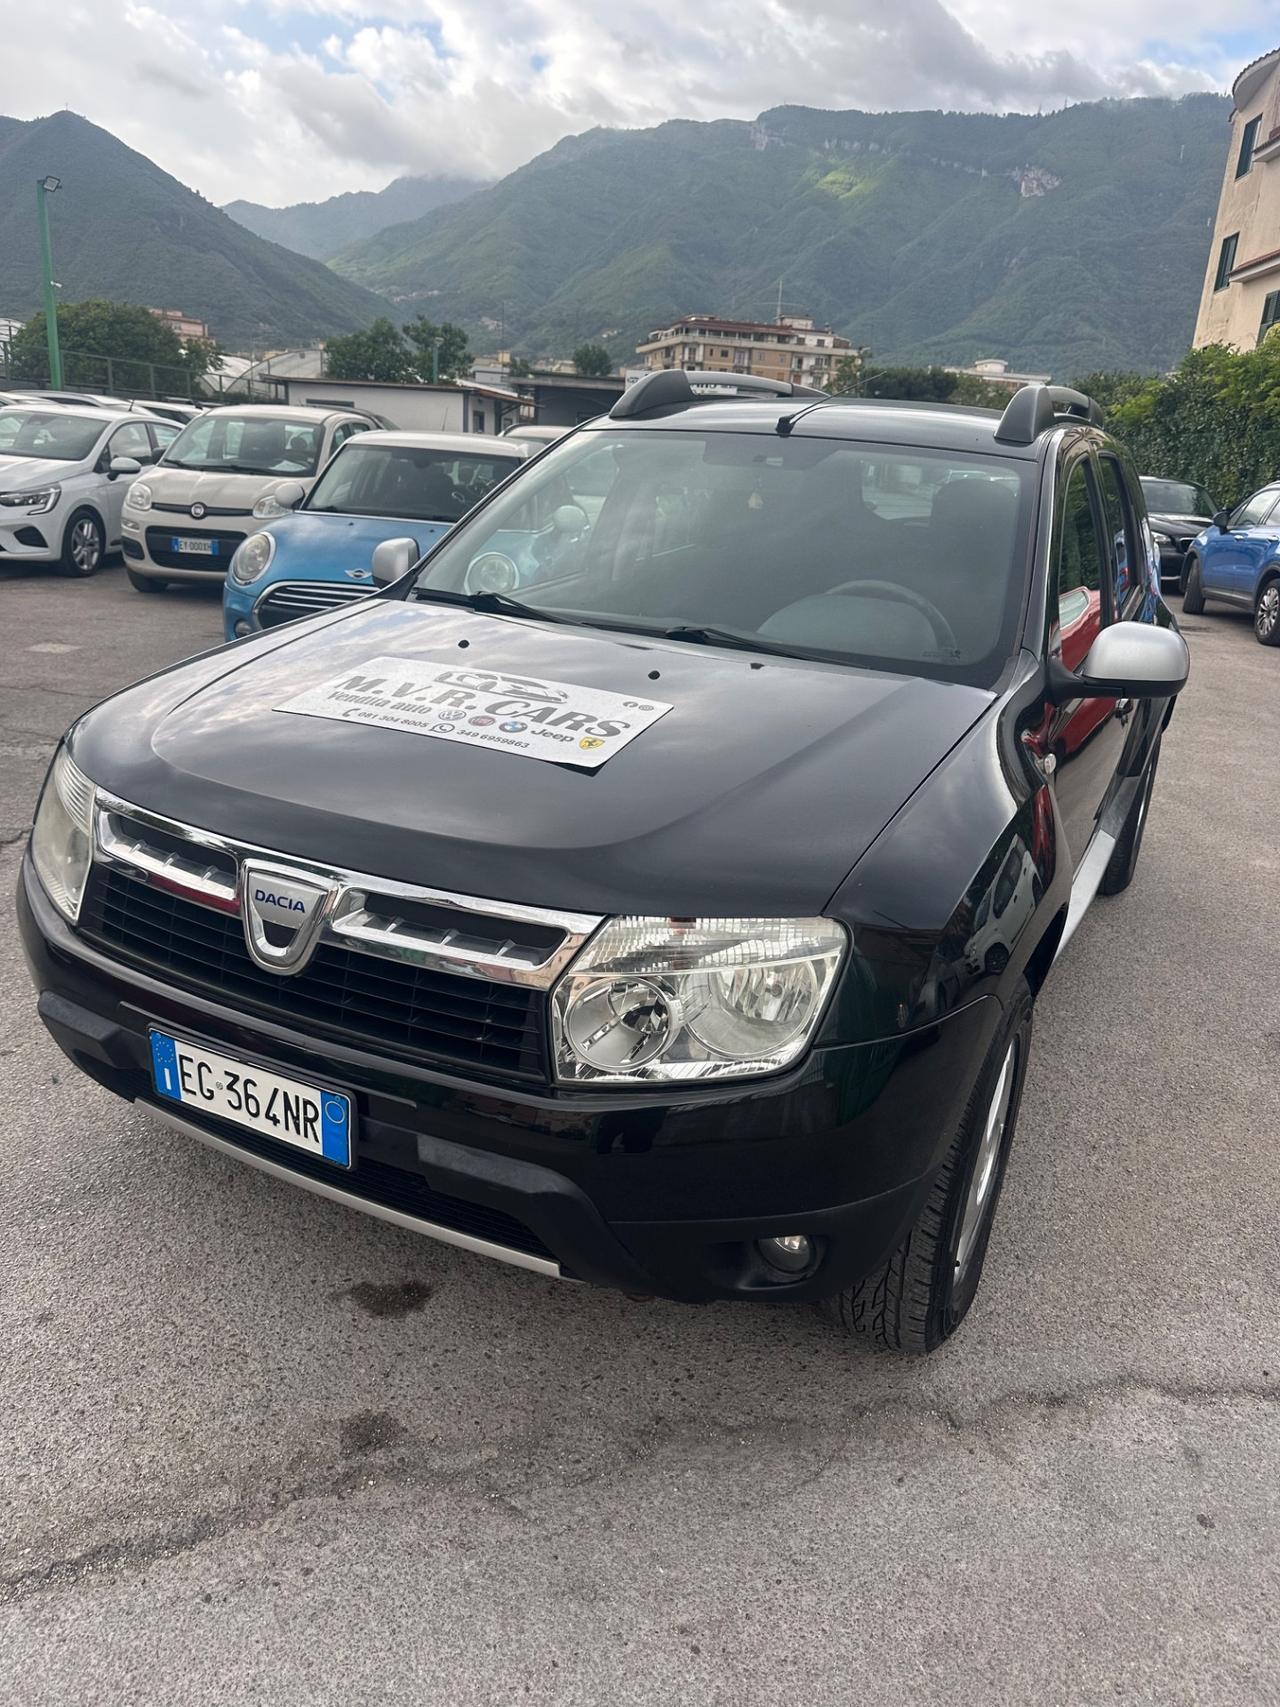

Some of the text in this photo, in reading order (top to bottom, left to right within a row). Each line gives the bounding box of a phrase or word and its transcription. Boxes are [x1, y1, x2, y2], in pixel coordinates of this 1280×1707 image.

[327, 691, 433, 715] Vendita auto
[334, 675, 631, 737] M.V.R. CARS
[357, 711, 379, 719] 081
[456, 729, 480, 738] 349
[530, 728, 575, 743] Jeep
[255, 889, 305, 913] DACIA
